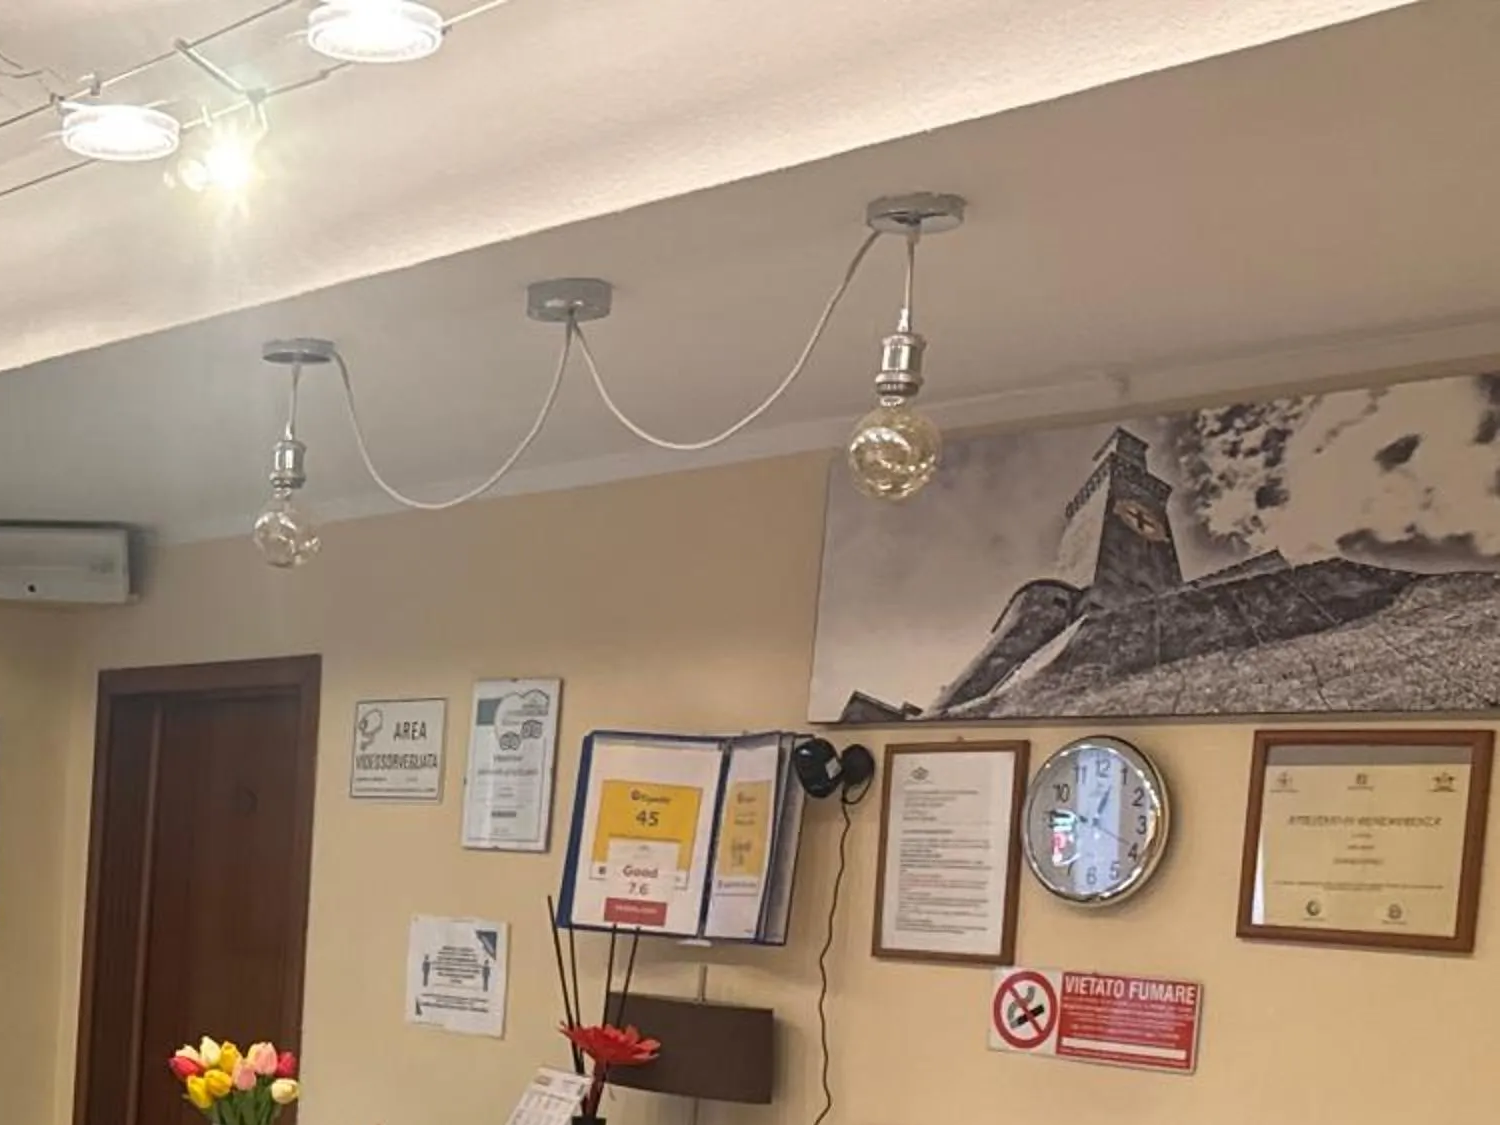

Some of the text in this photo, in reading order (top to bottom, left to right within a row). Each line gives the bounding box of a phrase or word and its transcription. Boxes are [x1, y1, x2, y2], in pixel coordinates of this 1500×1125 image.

[393, 720, 427, 741] AREA
[1074, 765, 1087, 786] 11
[1095, 758, 1110, 778] 12
[1120, 767, 1128, 785] 1
[1053, 783, 1070, 803] 10
[1133, 787, 1145, 807] 2
[635, 809, 661, 827] 45
[1136, 815, 1147, 835] 3
[1128, 842, 1138, 861] 4
[622, 864, 659, 879] Good
[1086, 866, 1097, 885] 6
[1109, 861, 1120, 880] 5
[1064, 974, 1197, 1005] VIETATO FUMARE
